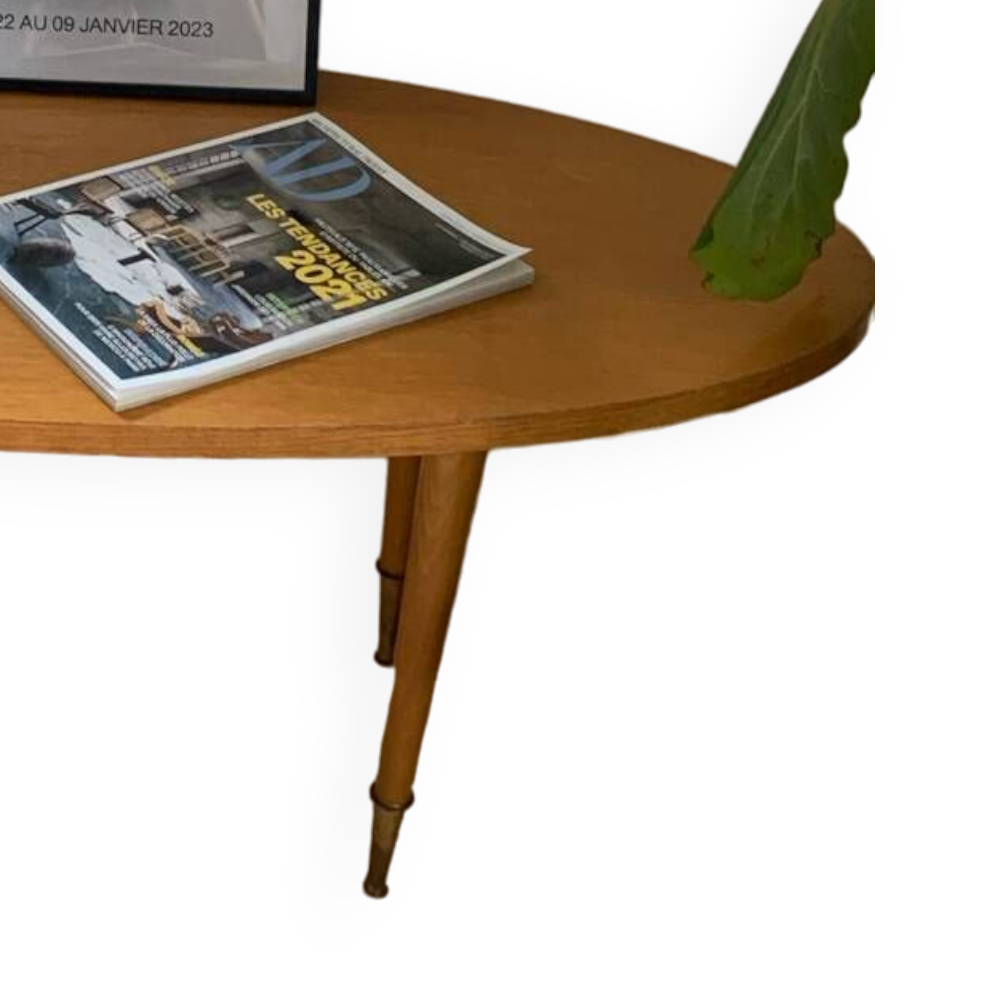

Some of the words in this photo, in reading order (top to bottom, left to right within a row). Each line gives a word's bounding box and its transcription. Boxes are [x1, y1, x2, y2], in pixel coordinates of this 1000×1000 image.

[19, 14, 46, 31] AU
[51, 16, 76, 32] 09
[80, 17, 162, 36] JANVIER
[168, 20, 214, 38] 2023
[246, 193, 288, 221] LES
[279, 216, 388, 301] TENDANCES
[275, 249, 367, 312] 2021
